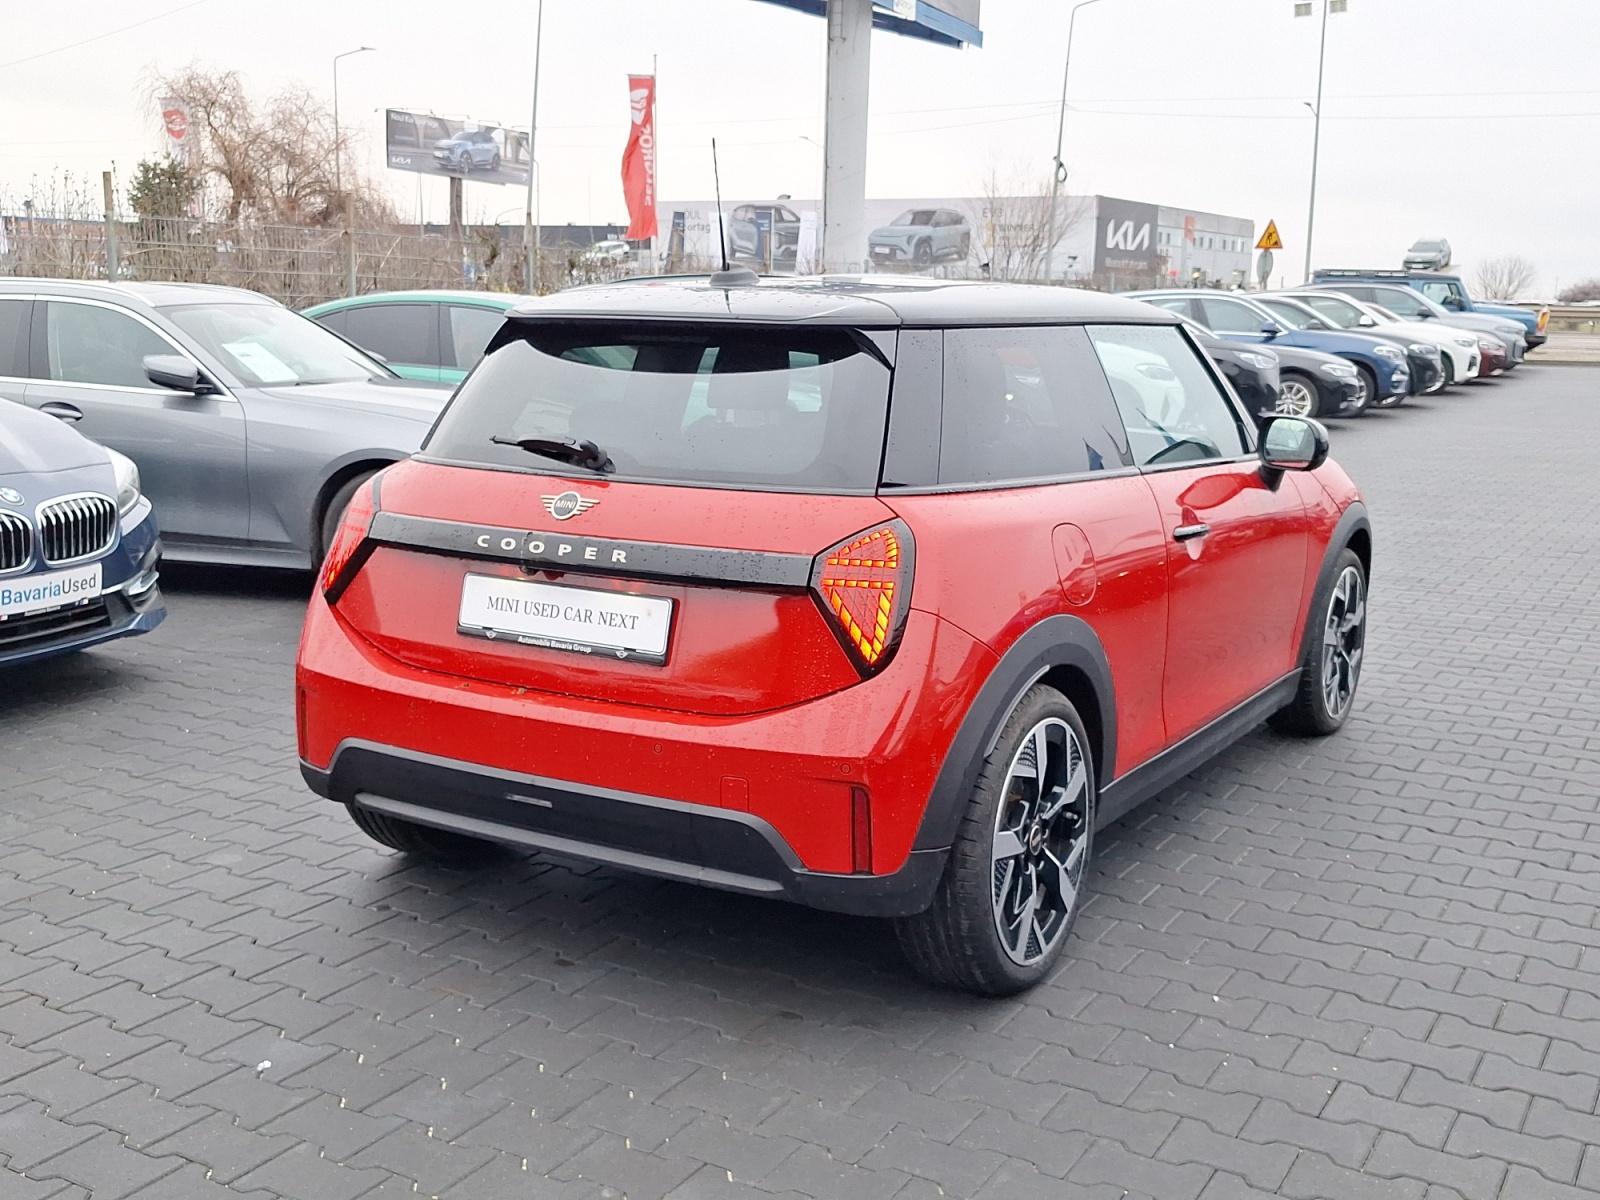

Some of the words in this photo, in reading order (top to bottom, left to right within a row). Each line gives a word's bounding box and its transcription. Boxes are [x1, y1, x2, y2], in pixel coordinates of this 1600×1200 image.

[392, 156, 411, 164] KIA
[1106, 219, 1151, 251] KIA
[555, 500, 577, 509] MINI
[477, 535, 627, 563] COOPER
[487, 596, 519, 614] MINI
[523, 601, 560, 619] USED
[564, 606, 594, 624] CAR
[598, 611, 639, 630] NEXT
[517, 636, 550, 648] Automobile
[551, 640, 573, 650] Bavaria
[573, 644, 592, 654] Group
